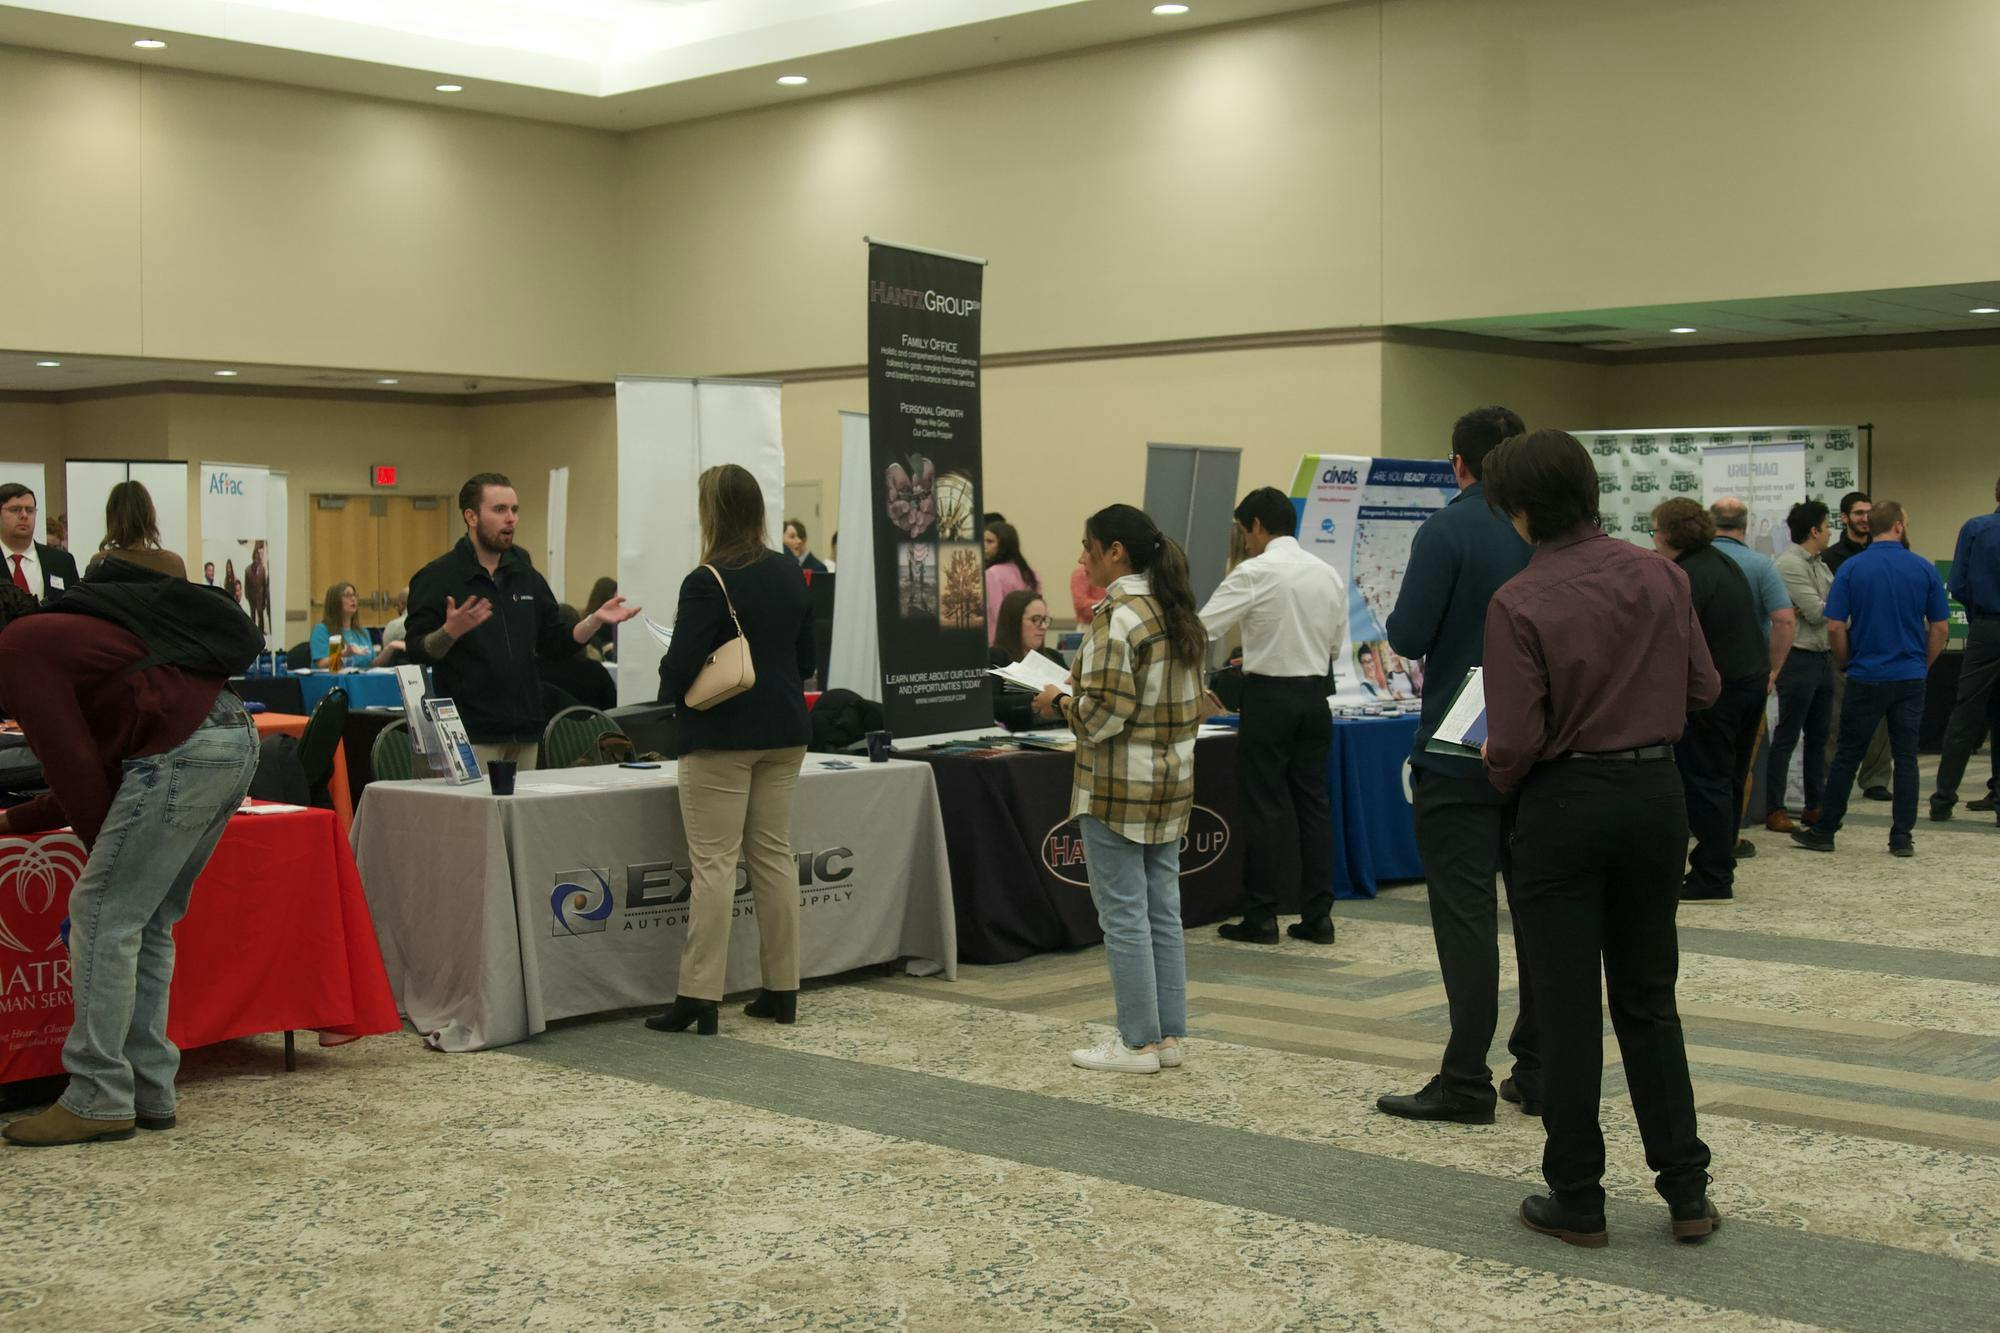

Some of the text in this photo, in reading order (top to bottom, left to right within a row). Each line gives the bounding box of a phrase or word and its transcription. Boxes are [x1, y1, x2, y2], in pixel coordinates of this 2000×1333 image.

[886, 673, 908, 685] LEARN
[909, 673, 928, 683] MORE
[929, 671, 949, 682] ABOUT
